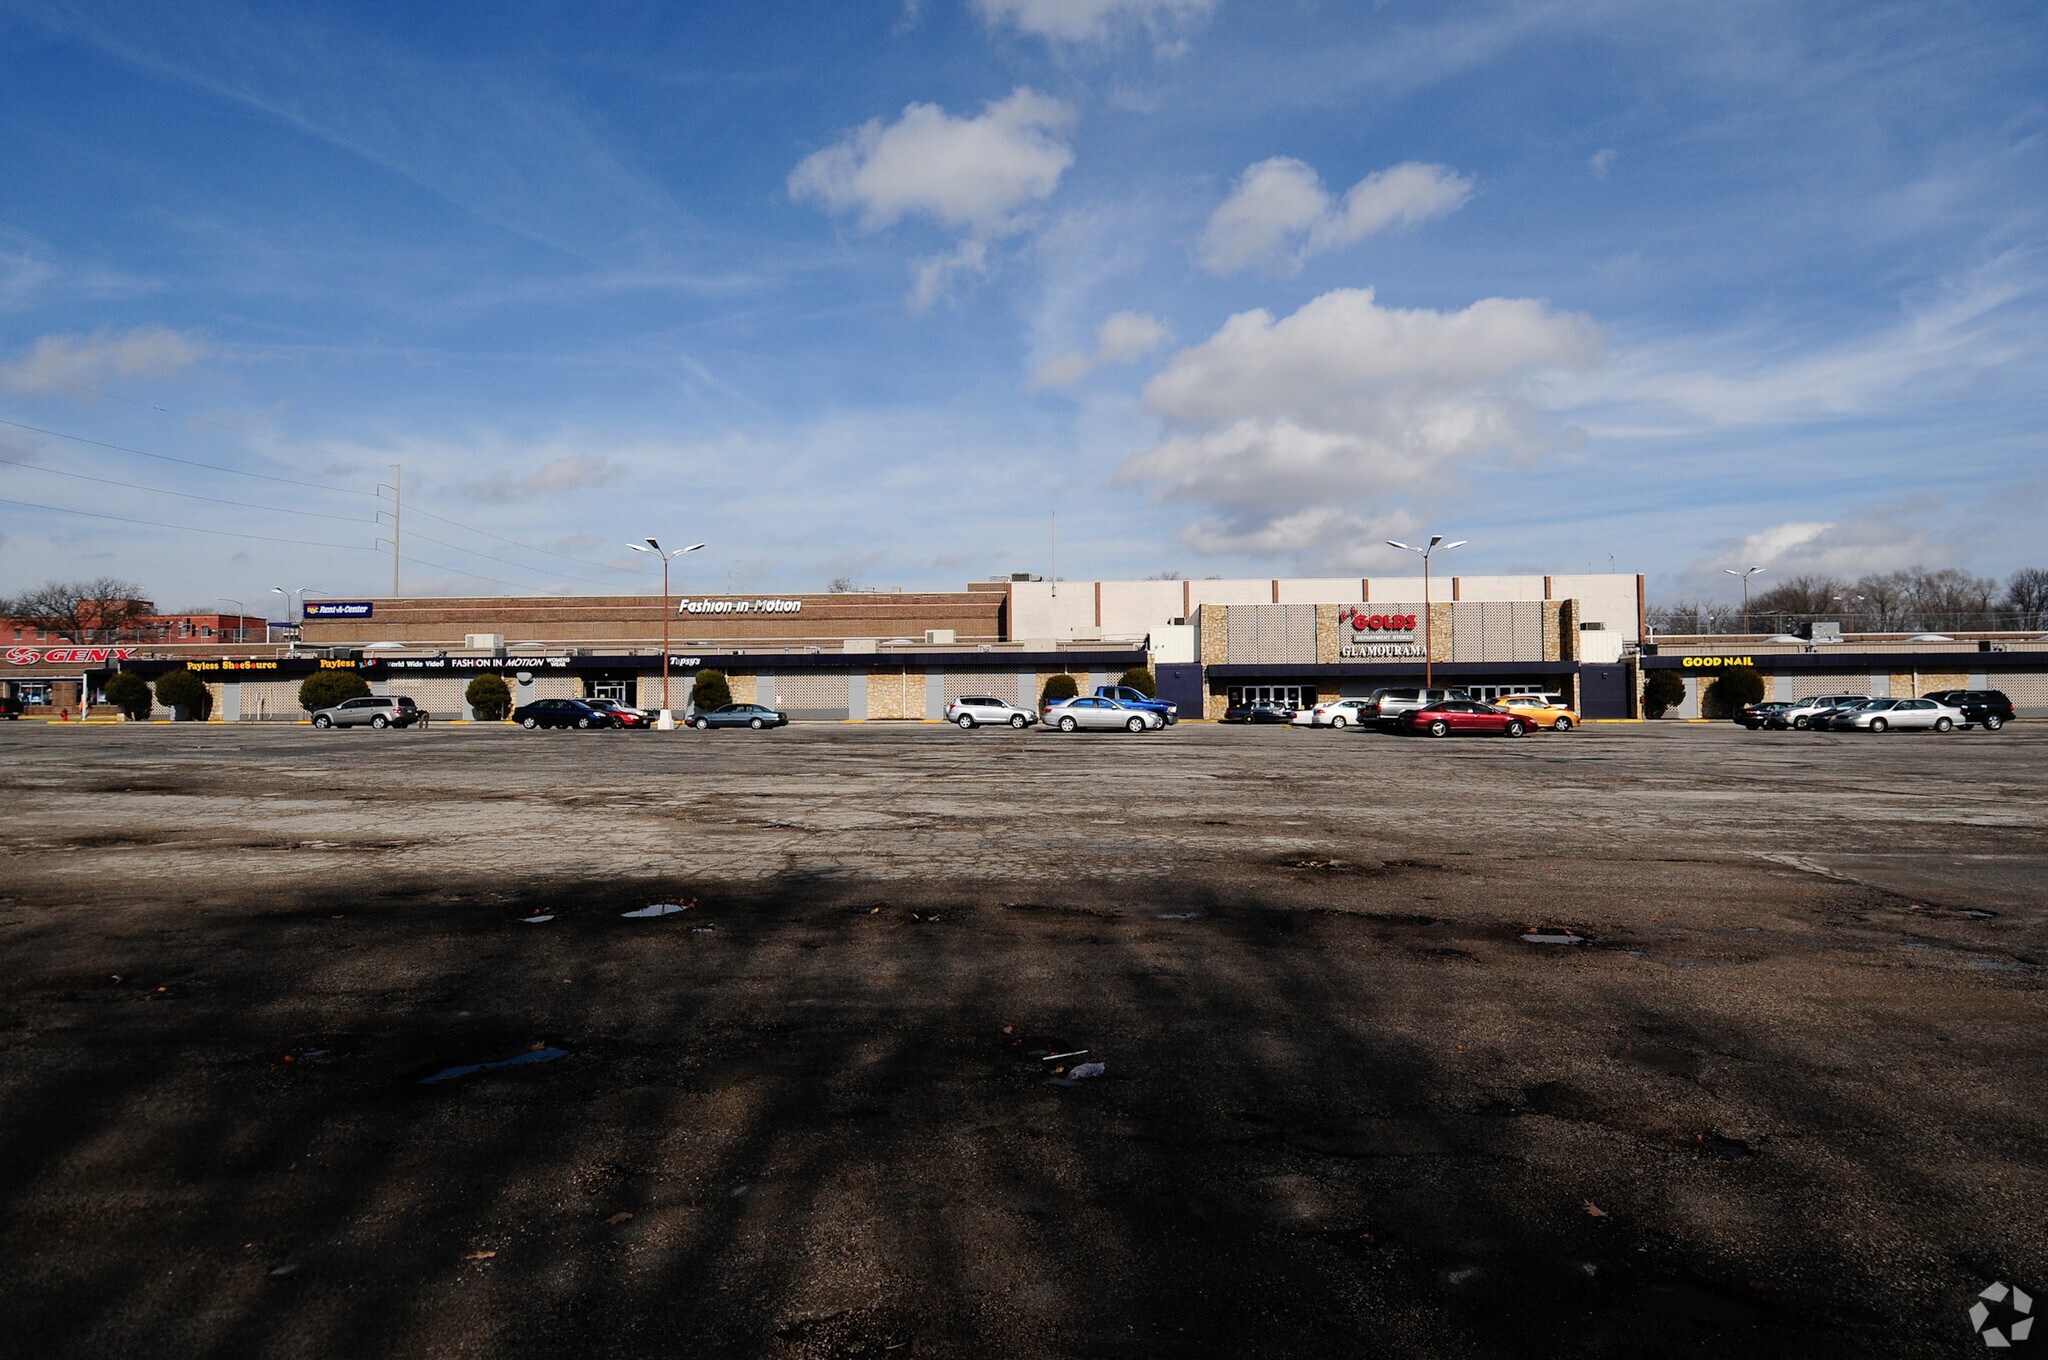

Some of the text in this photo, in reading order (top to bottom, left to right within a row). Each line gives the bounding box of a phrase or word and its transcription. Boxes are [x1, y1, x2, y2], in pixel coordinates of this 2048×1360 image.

[319, 605, 368, 614] Rent-A-Center
[679, 599, 802, 614] Fashion in Motion
[1353, 614, 1417, 630] GOLDS
[1342, 645, 1428, 656] GLAMOURAMA
[187, 661, 219, 671] Payless
[320, 659, 356, 669] Payless
[386, 660, 405, 668] World
[425, 659, 445, 668] Video
[492, 659, 503, 667] IN
[505, 658, 545, 667] MOTION
[1682, 656, 1754, 667] GOOD NAIL
